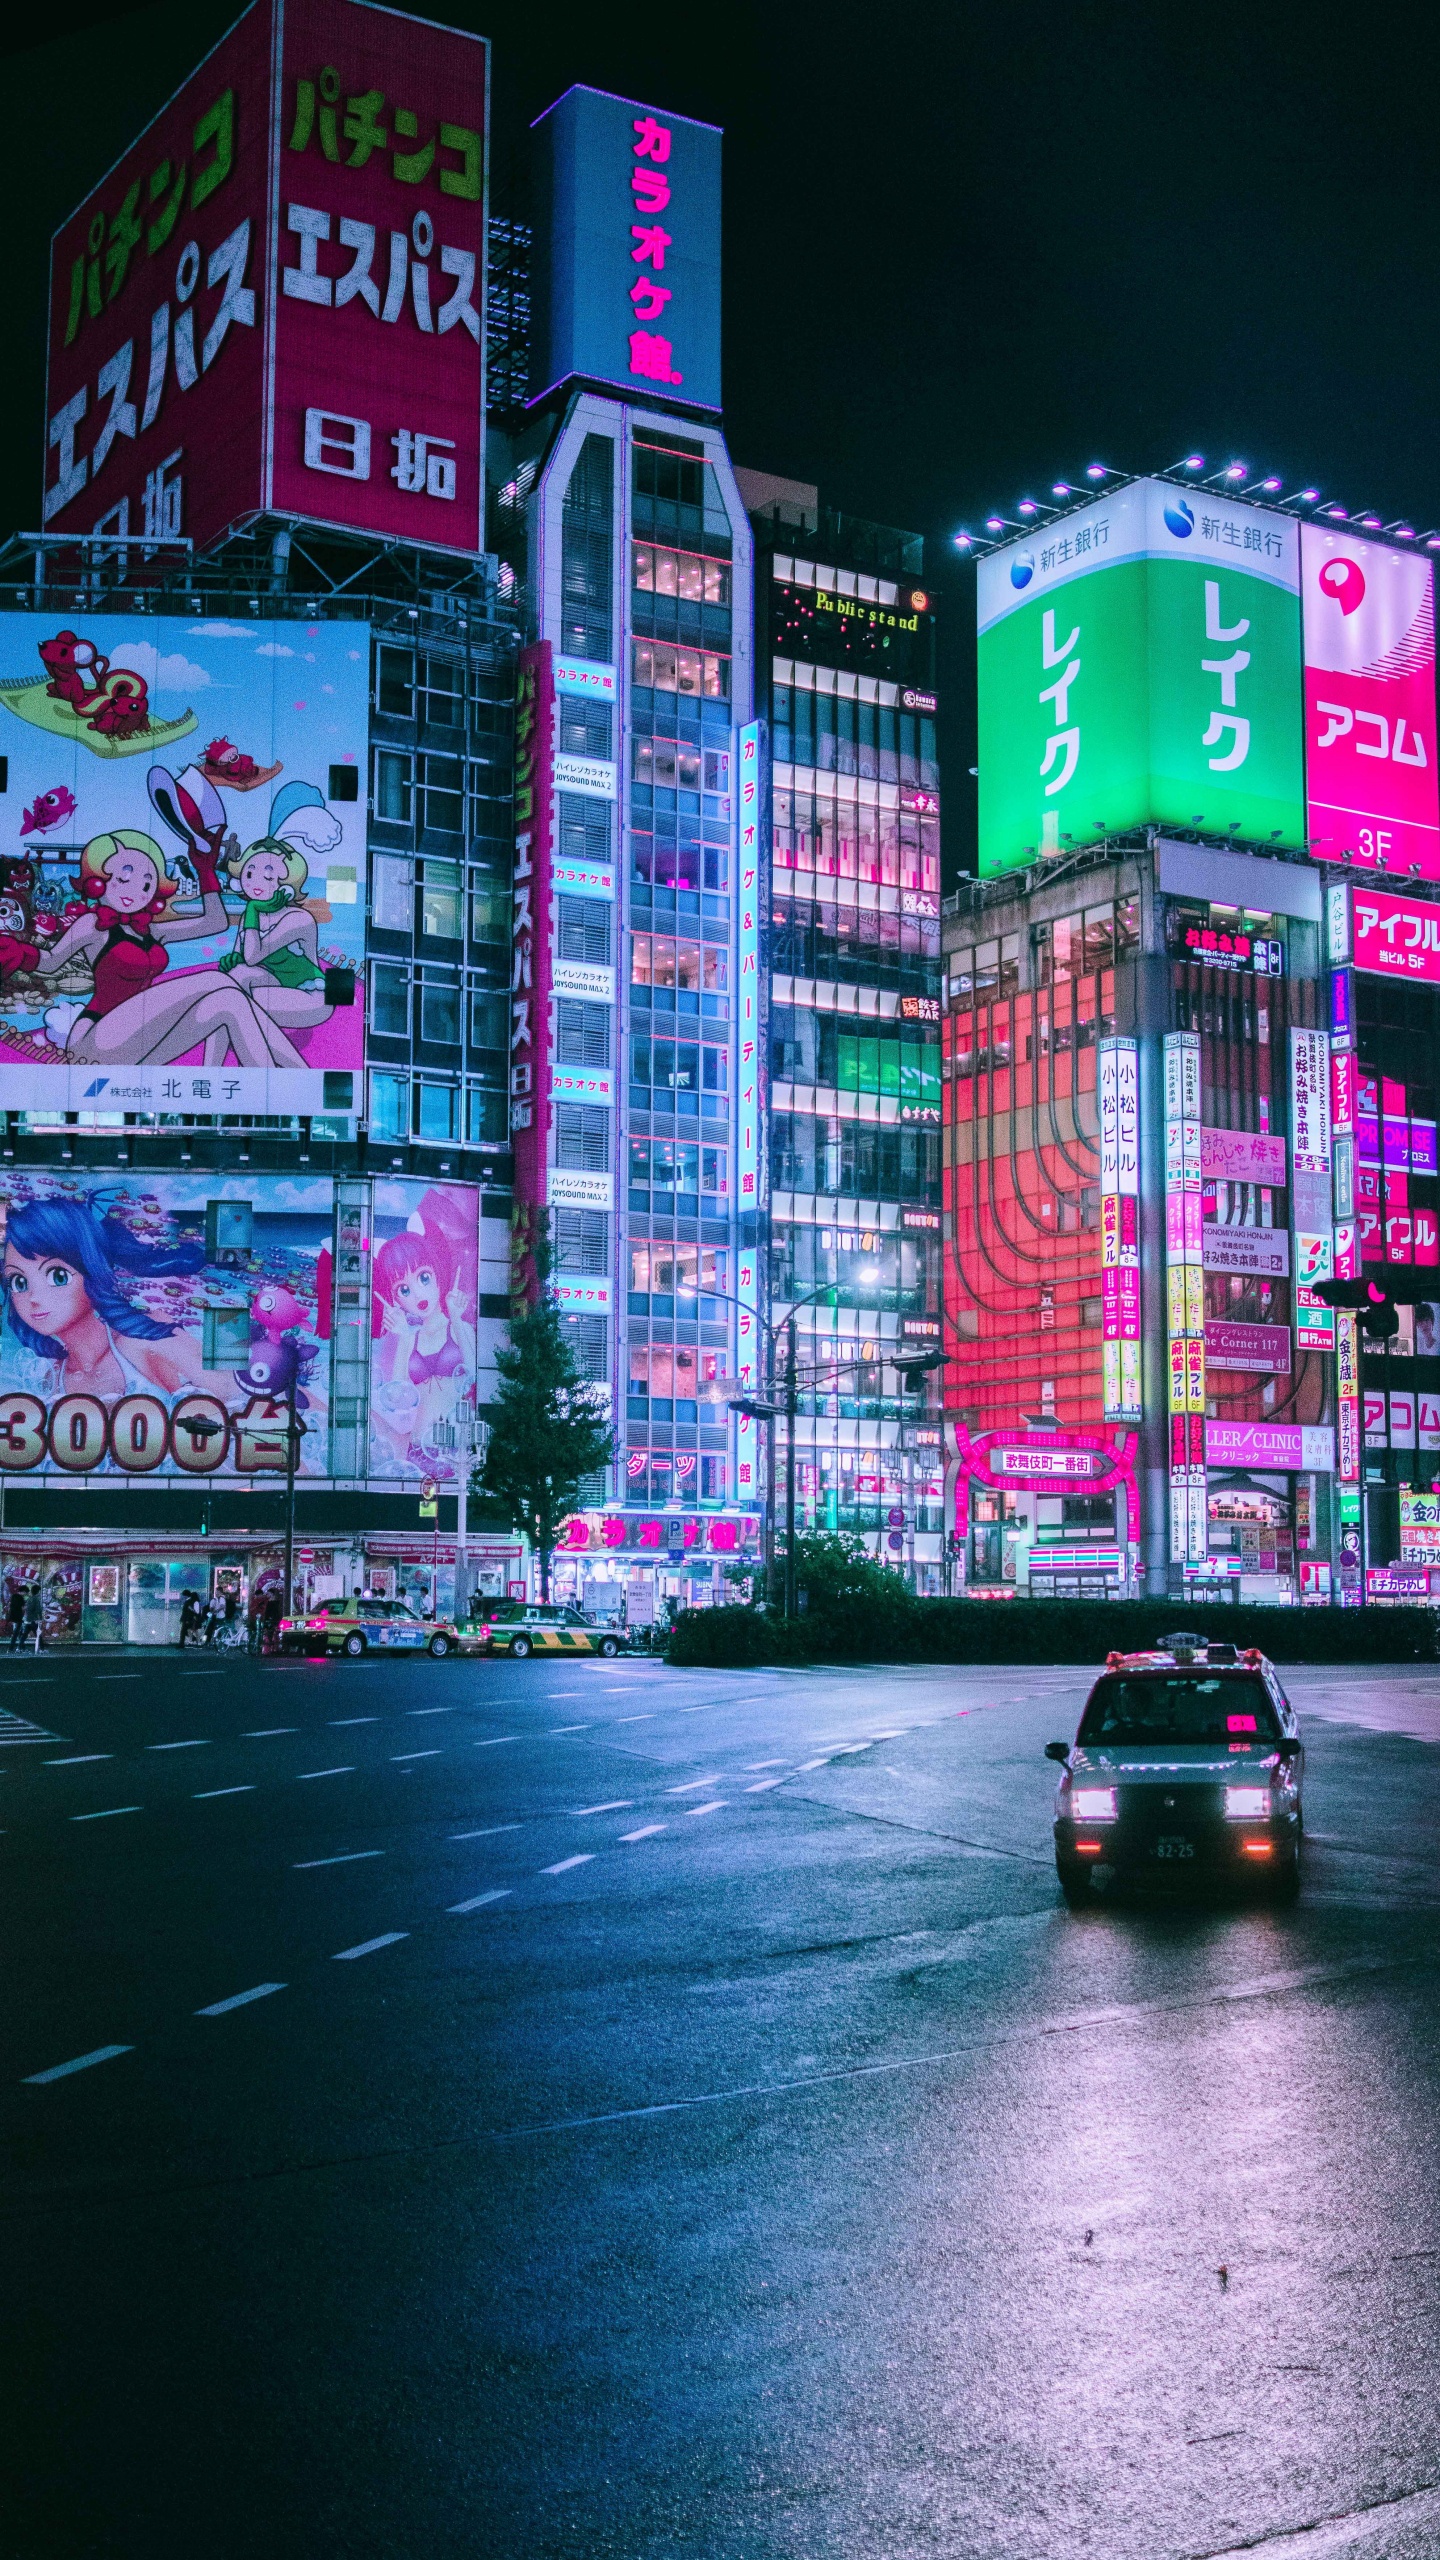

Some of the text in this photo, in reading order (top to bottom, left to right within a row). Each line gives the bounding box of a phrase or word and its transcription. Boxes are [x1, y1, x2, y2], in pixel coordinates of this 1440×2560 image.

[288, 66, 481, 201] パチンコ
[64, 87, 234, 349] パチンコ
[283, 203, 480, 345] エスパス
[43, 217, 256, 525] エスパス
[304, 407, 456, 501] 日拓
[1040, 519, 1110, 573] 新生銀行
[1202, 516, 1283, 558] 新生銀行
[815, 591, 865, 619] Public
[557, 668, 613, 688] カラオケ館
[1202, 580, 1250, 771] レイク
[1039, 608, 1080, 797] レイク
[515, 665, 537, 821] パチンコ
[1316, 700, 1427, 768] アコム
[556, 762, 611, 778] ハイレゾカラオケ
[556, 773, 611, 790] JOYSOUND MAX 2
[1358, 828, 1393, 858] 3F
[556, 868, 611, 887] カラオケ館
[1355, 905, 1440, 952] アイフル
[512, 833, 533, 1048] エスパス
[743, 739, 756, 1194] カラオケ&パーティー館
[1379, 949, 1425, 969] 当ビル 5F
[554, 968, 609, 983] ハイレゾカラオケ
[553, 979, 610, 995] JOYSOUND MAX 2
[1336, 1038, 1345, 1046] 6F
[110, 1078, 242, 1100] 株式会社 北電子
[553, 1076, 610, 1093] カラオケ館
[1318, 1034, 1327, 1153] OKONOMIYAKI HONJIN
[1295, 1044, 1309, 1151] お好み焼き本陣
[1336, 1071, 1348, 1121] アイフル
[1103, 1064, 1117, 1173] 小松ビル
[1120, 1064, 1136, 1172] 小松ビル
[1201, 1133, 1224, 1151] 好み
[1359, 1123, 1431, 1151] PROMSE
[551, 1187, 608, 1202] JOYSOUND MAX 2
[552, 1177, 608, 1190] ハイレゾカラオケ
[1103, 1196, 1116, 1263] 麻雀ブル
[1203, 1227, 1273, 1241] KONOMIYAKI HONJIN
[1359, 1212, 1436, 1247] アイフル
[1203, 1250, 1259, 1267] 好み焼き本陣
[1391, 1248, 1405, 1260] 5F
[1340, 1256, 1350, 1279] アコ
[1123, 1323, 1136, 1335] 4F
[1307, 1310, 1323, 1326] 酒
[1106, 1324, 1117, 1336] 4F
[1205, 1335, 1278, 1351] he Corner 117
[1171, 1341, 1184, 1398] 麻雀ブル
[1188, 1340, 1202, 1398] 麻雀ブル
[1275, 1358, 1287, 1369] 4F
[1339, 1338, 1351, 1381] 金の蔵
[1342, 1383, 1354, 1395] 2F
[1174, 1400, 1183, 1410] 6F
[1191, 1399, 1201, 1410] 6F
[1364, 1400, 1440, 1431] アコム
[0, 1393, 300, 1472] 3000台
[1205, 1429, 1301, 1451] LLER CLINIC
[1309, 1431, 1329, 1443] 美容
[1341, 1402, 1350, 1475] 東京チカラめし
[1367, 1436, 1379, 1446] 3F
[1221, 1450, 1260, 1463] クリニック
[1305, 1444, 1332, 1456] 皮膚科
[626, 1454, 697, 1477] ダーツ
[1005, 1453, 1089, 1472] 歌舞伎町一番街
[1313, 1457, 1323, 1466] 3F
[1342, 1505, 1358, 1513] レイク
[670, 1520, 681, 1537] P
